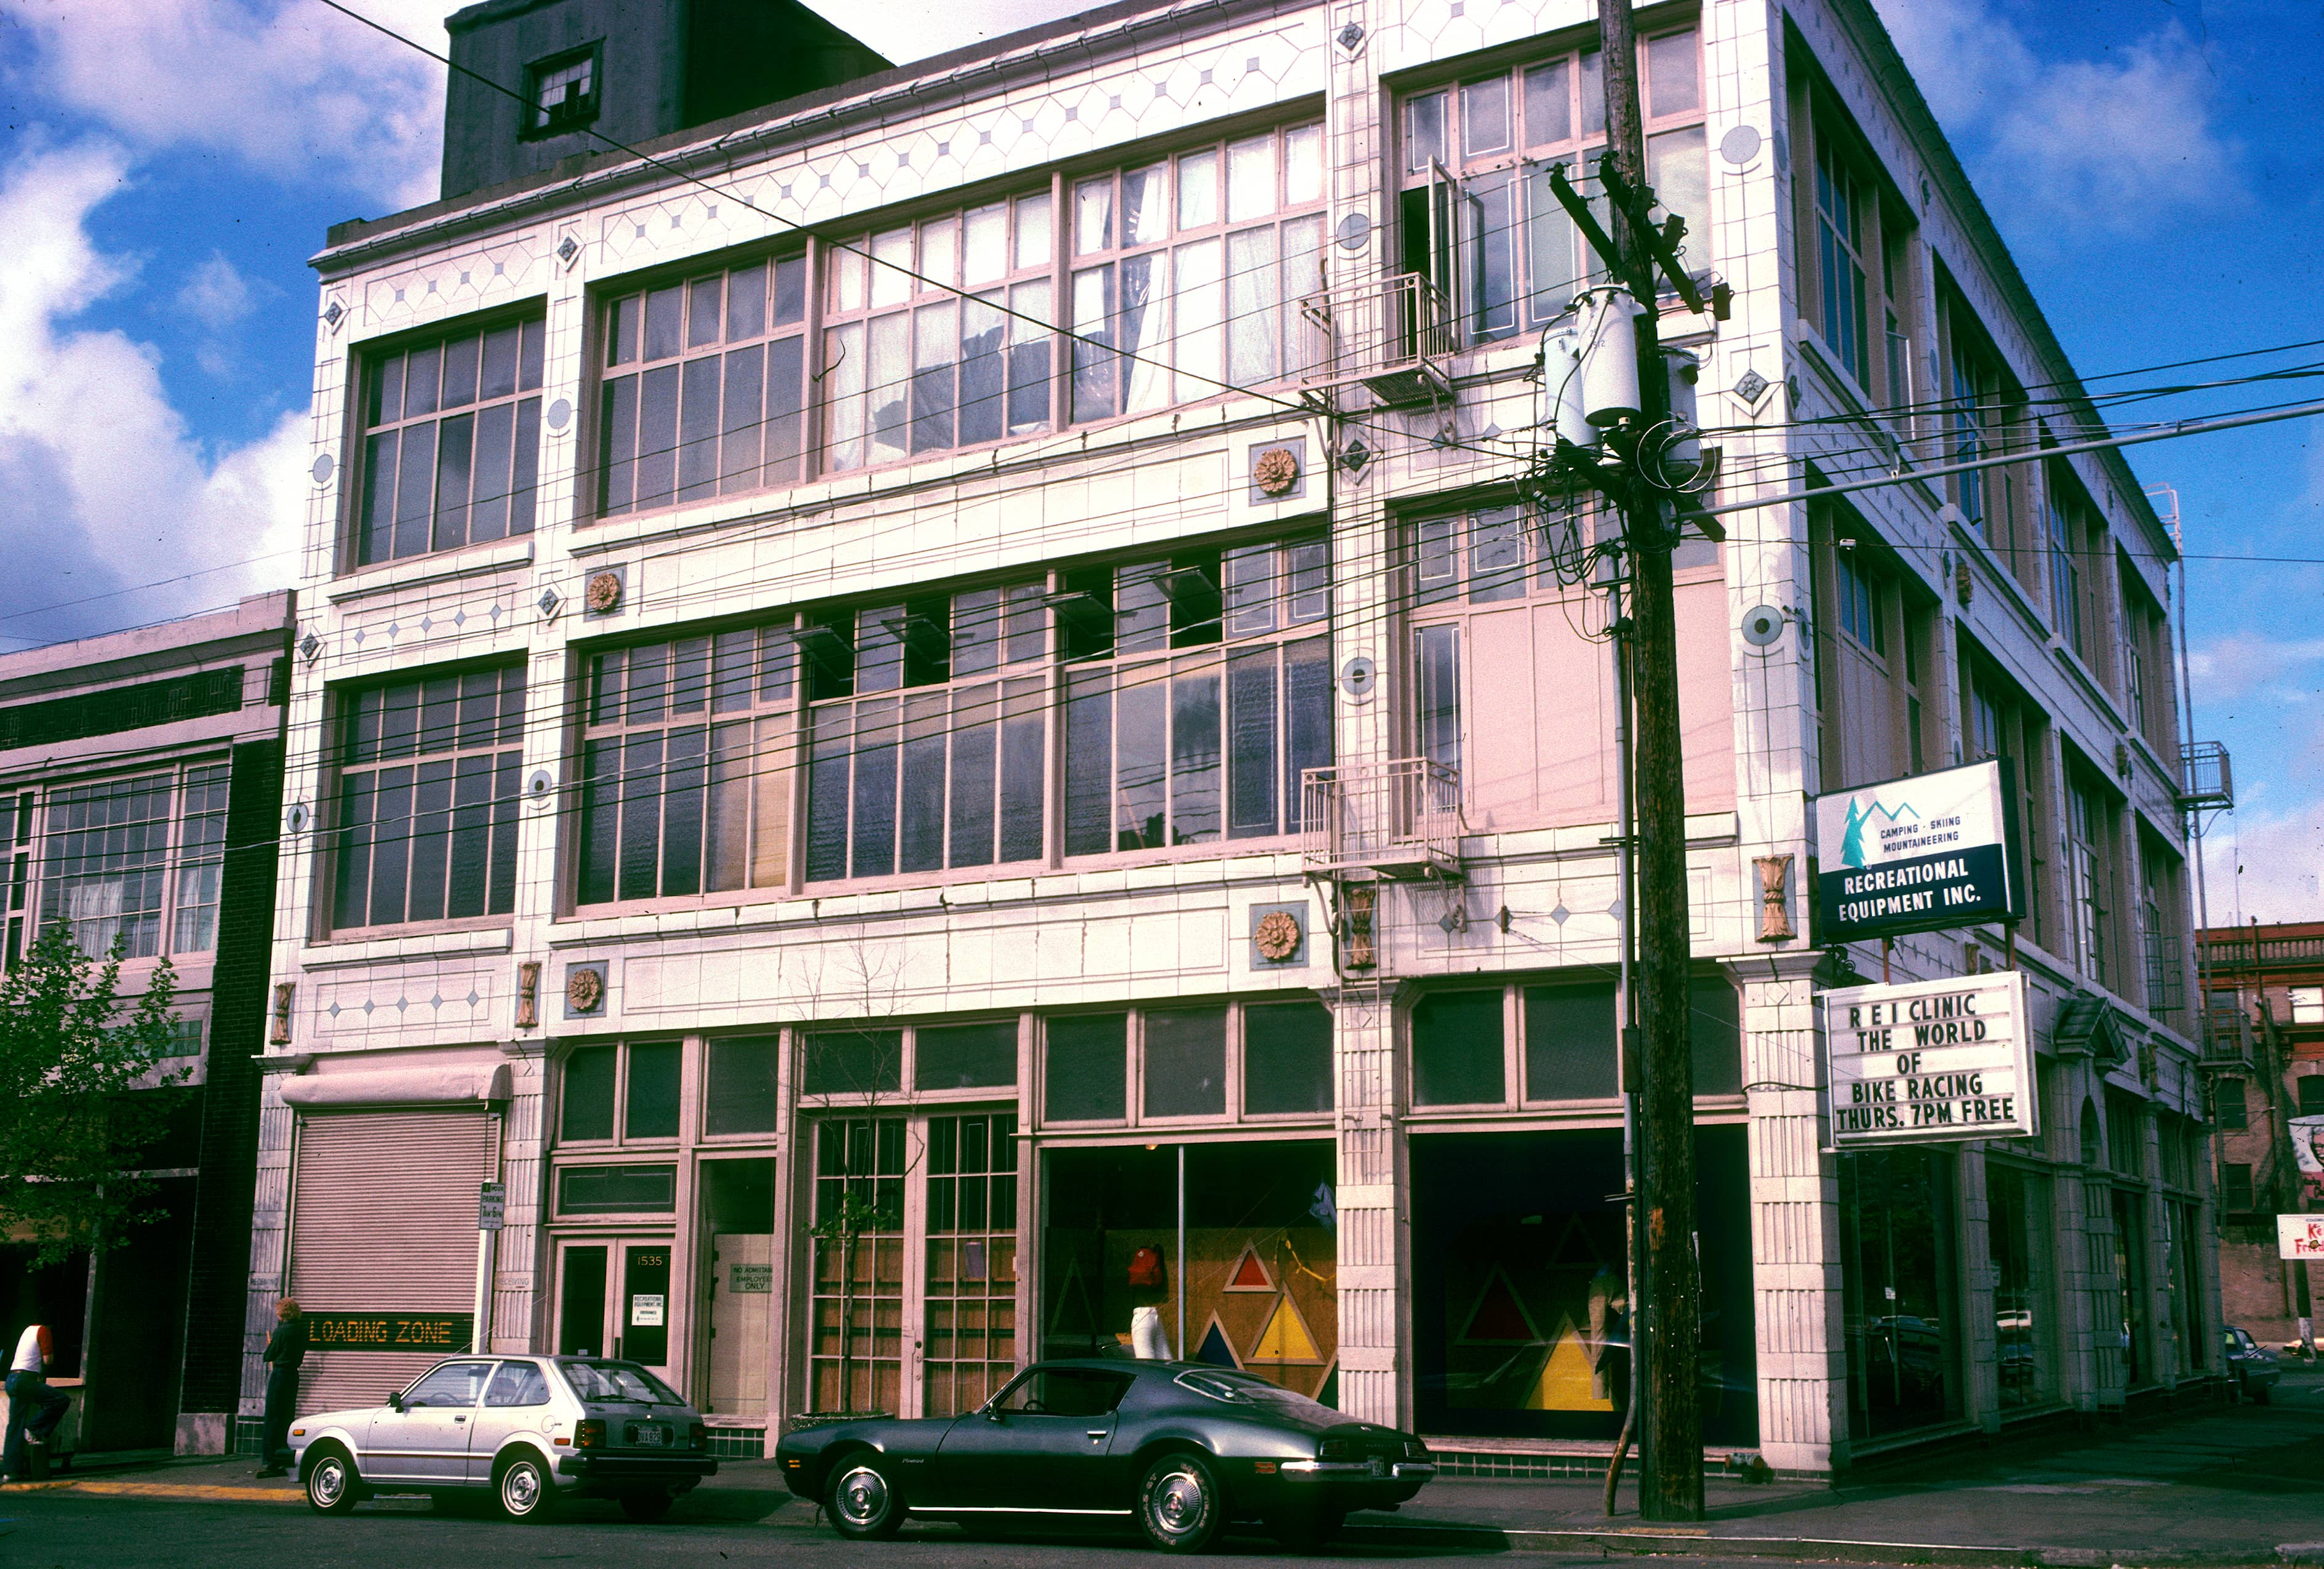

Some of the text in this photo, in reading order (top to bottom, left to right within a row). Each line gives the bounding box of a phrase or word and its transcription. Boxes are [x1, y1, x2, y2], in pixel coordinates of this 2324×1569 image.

[1880, 816, 1961, 839] CAMPING SKIING
[1883, 831, 1959, 853] MOUNTAINEERING
[1845, 858, 1969, 895] RECREATIONAL
[1839, 884, 1981, 922] EQUIPMENT INC.
[1909, 994, 1976, 1021] CLINIC
[1857, 1020, 1986, 1052] THE WORLD
[1897, 1053, 1921, 1074] OF
[1852, 1073, 1983, 1103] BIKE RACING
[1837, 1098, 2014, 1129] THURS. 7PM FREE
[637, 1256, 662, 1266] 1535
[309, 1320, 452, 1343] LOADING ZONE
